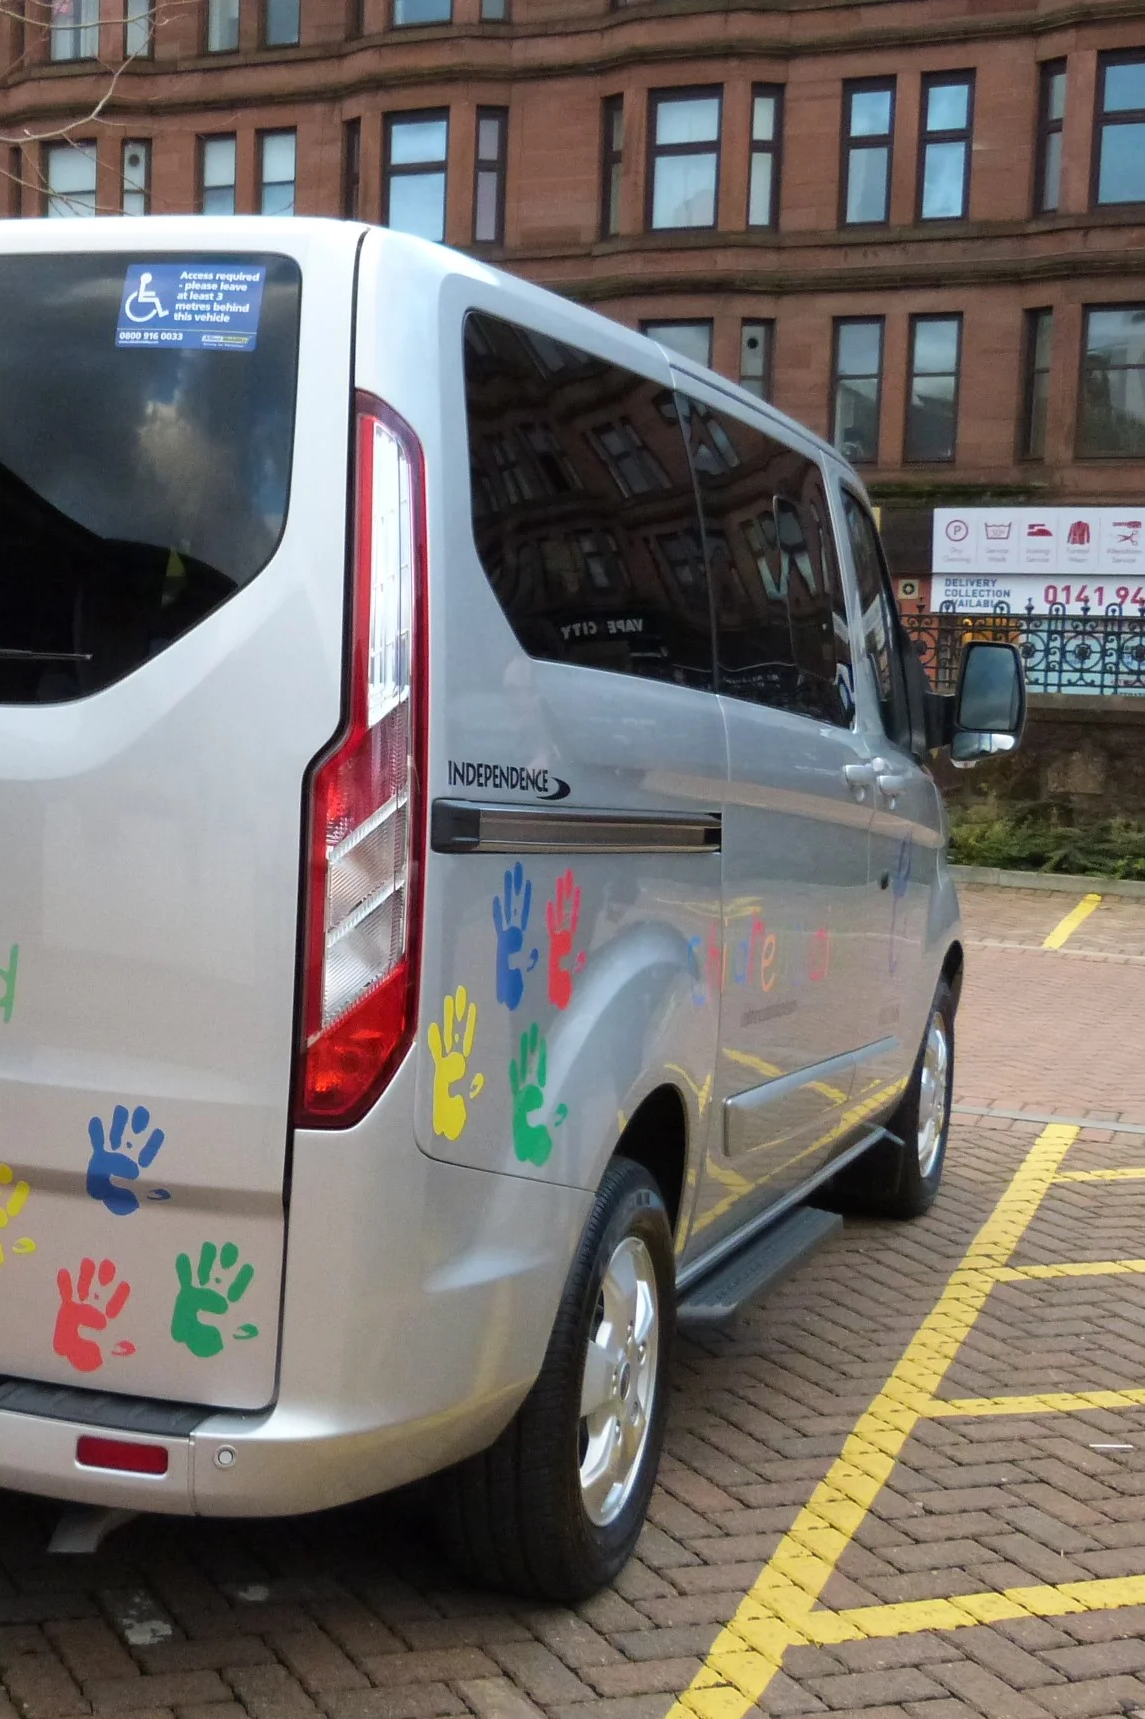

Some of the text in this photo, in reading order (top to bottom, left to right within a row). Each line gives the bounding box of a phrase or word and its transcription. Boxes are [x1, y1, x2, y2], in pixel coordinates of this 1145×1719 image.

[180, 271, 260, 282] Access required
[184, 282, 217, 294] please
[220, 282, 248, 291] leave
[177, 291, 223, 301] at least 3
[175, 303, 250, 313] metres behind
[173, 312, 230, 323] this vehicle
[119, 331, 183, 340] 0800 916 0033
[944, 578, 997, 588] DELIVERY
[944, 588, 1011, 598] COLLECTION
[1044, 584, 1104, 606] 0141
[448, 760, 549, 793] INDEPENDENCE
